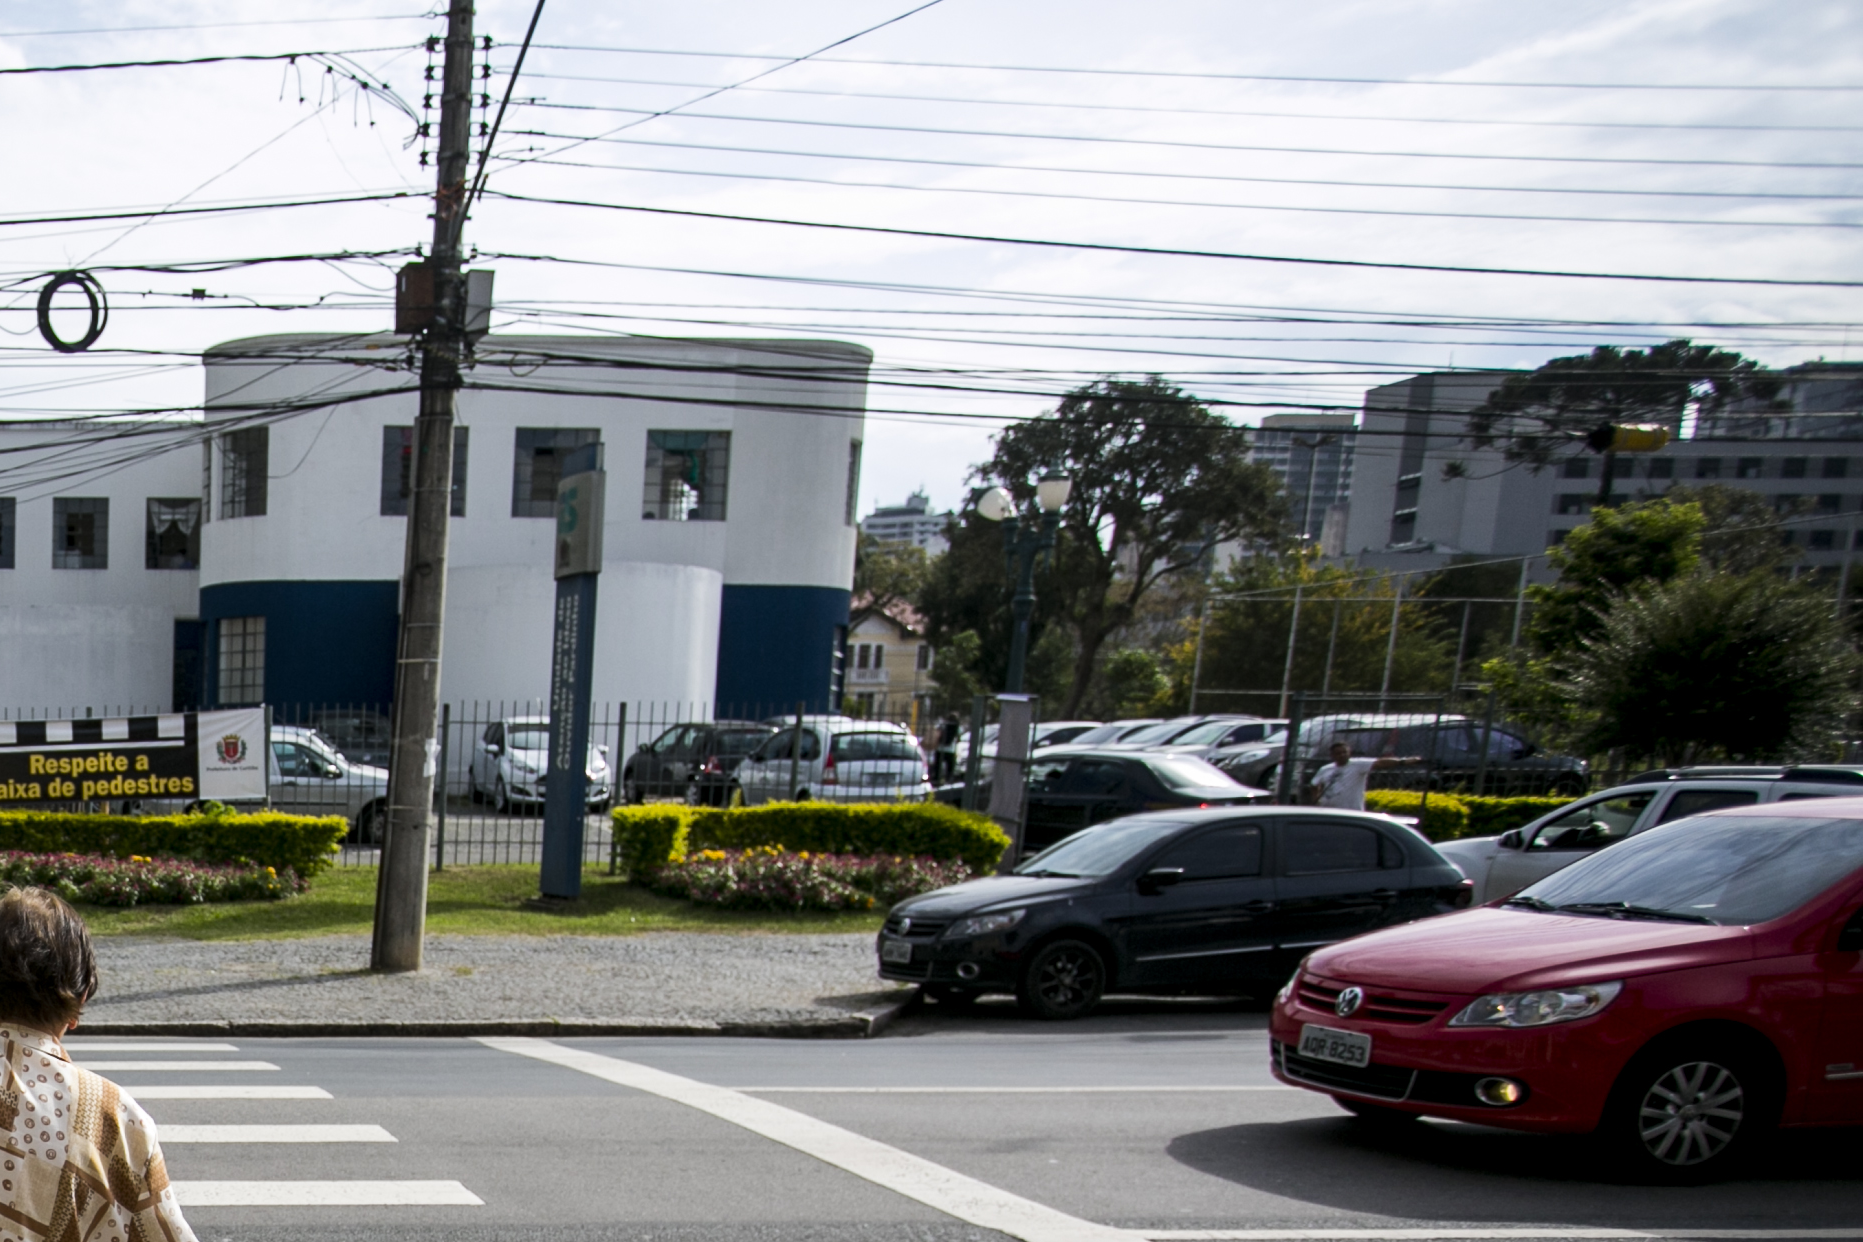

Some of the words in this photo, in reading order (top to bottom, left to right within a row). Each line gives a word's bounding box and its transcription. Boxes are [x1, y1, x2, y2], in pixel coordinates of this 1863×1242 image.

[29, 752, 128, 777] Respeite
[135, 754, 150, 771] a
[47, 777, 75, 797] de
[82, 774, 195, 800] pedestres
